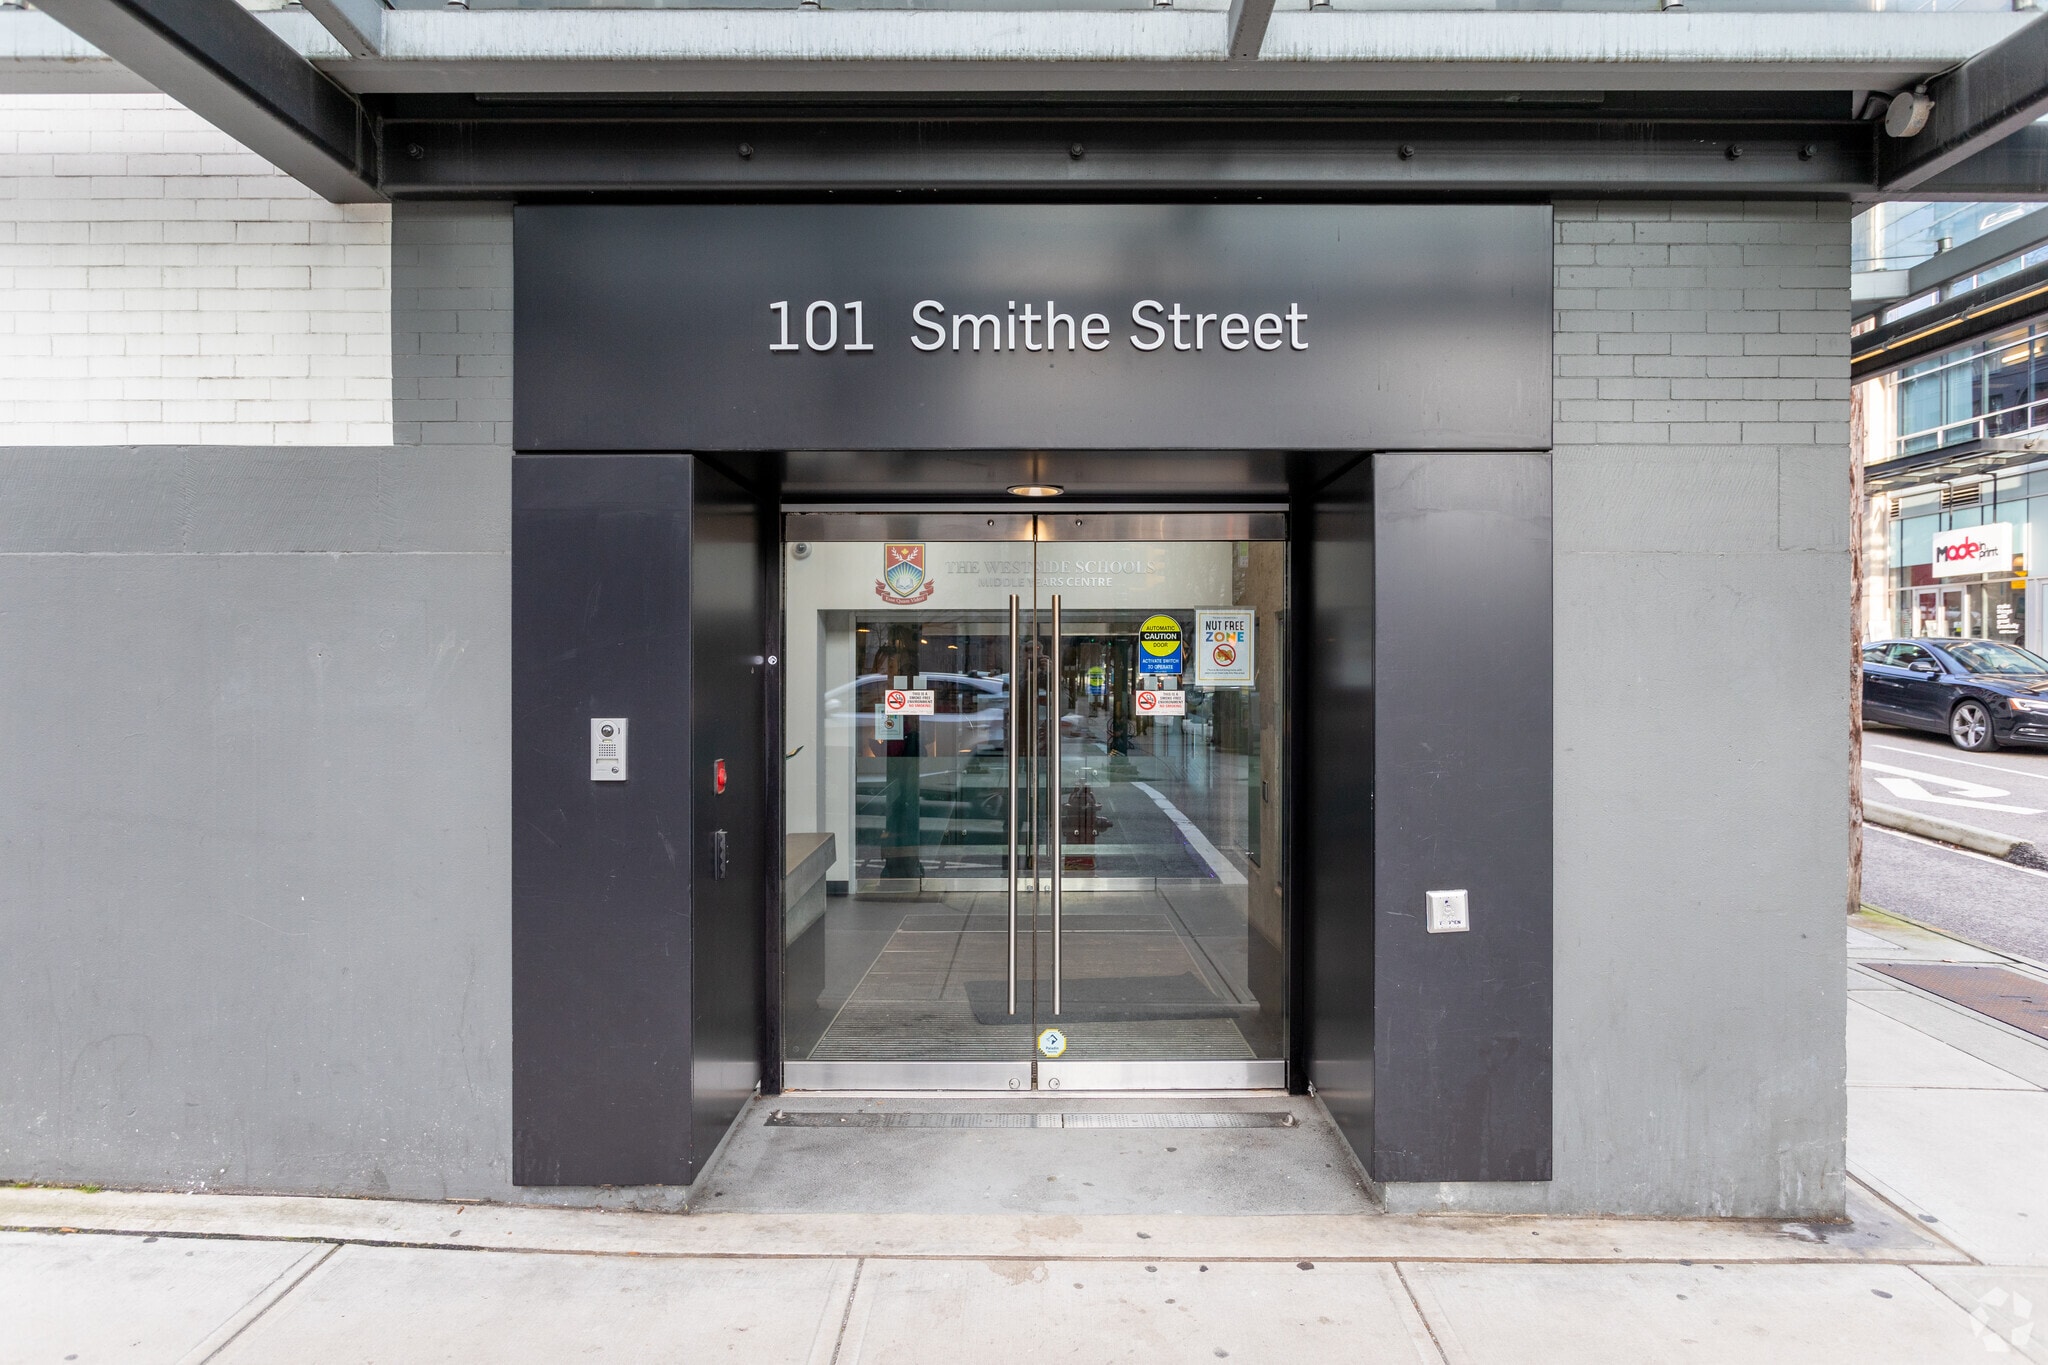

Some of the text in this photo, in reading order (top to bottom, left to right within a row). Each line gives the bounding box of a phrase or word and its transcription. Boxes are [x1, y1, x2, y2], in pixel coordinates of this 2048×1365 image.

[769, 299, 1309, 351] 101 Smithe Street
[945, 560, 1156, 574] THE WESTSIDE SCHOOLS
[978, 577, 1113, 588] MIDDLE YEARS CENTRE
[1205, 620, 1245, 631] NUT FREE
[1144, 632, 1177, 640] CAUTION
[1205, 631, 1245, 642] ZONE
